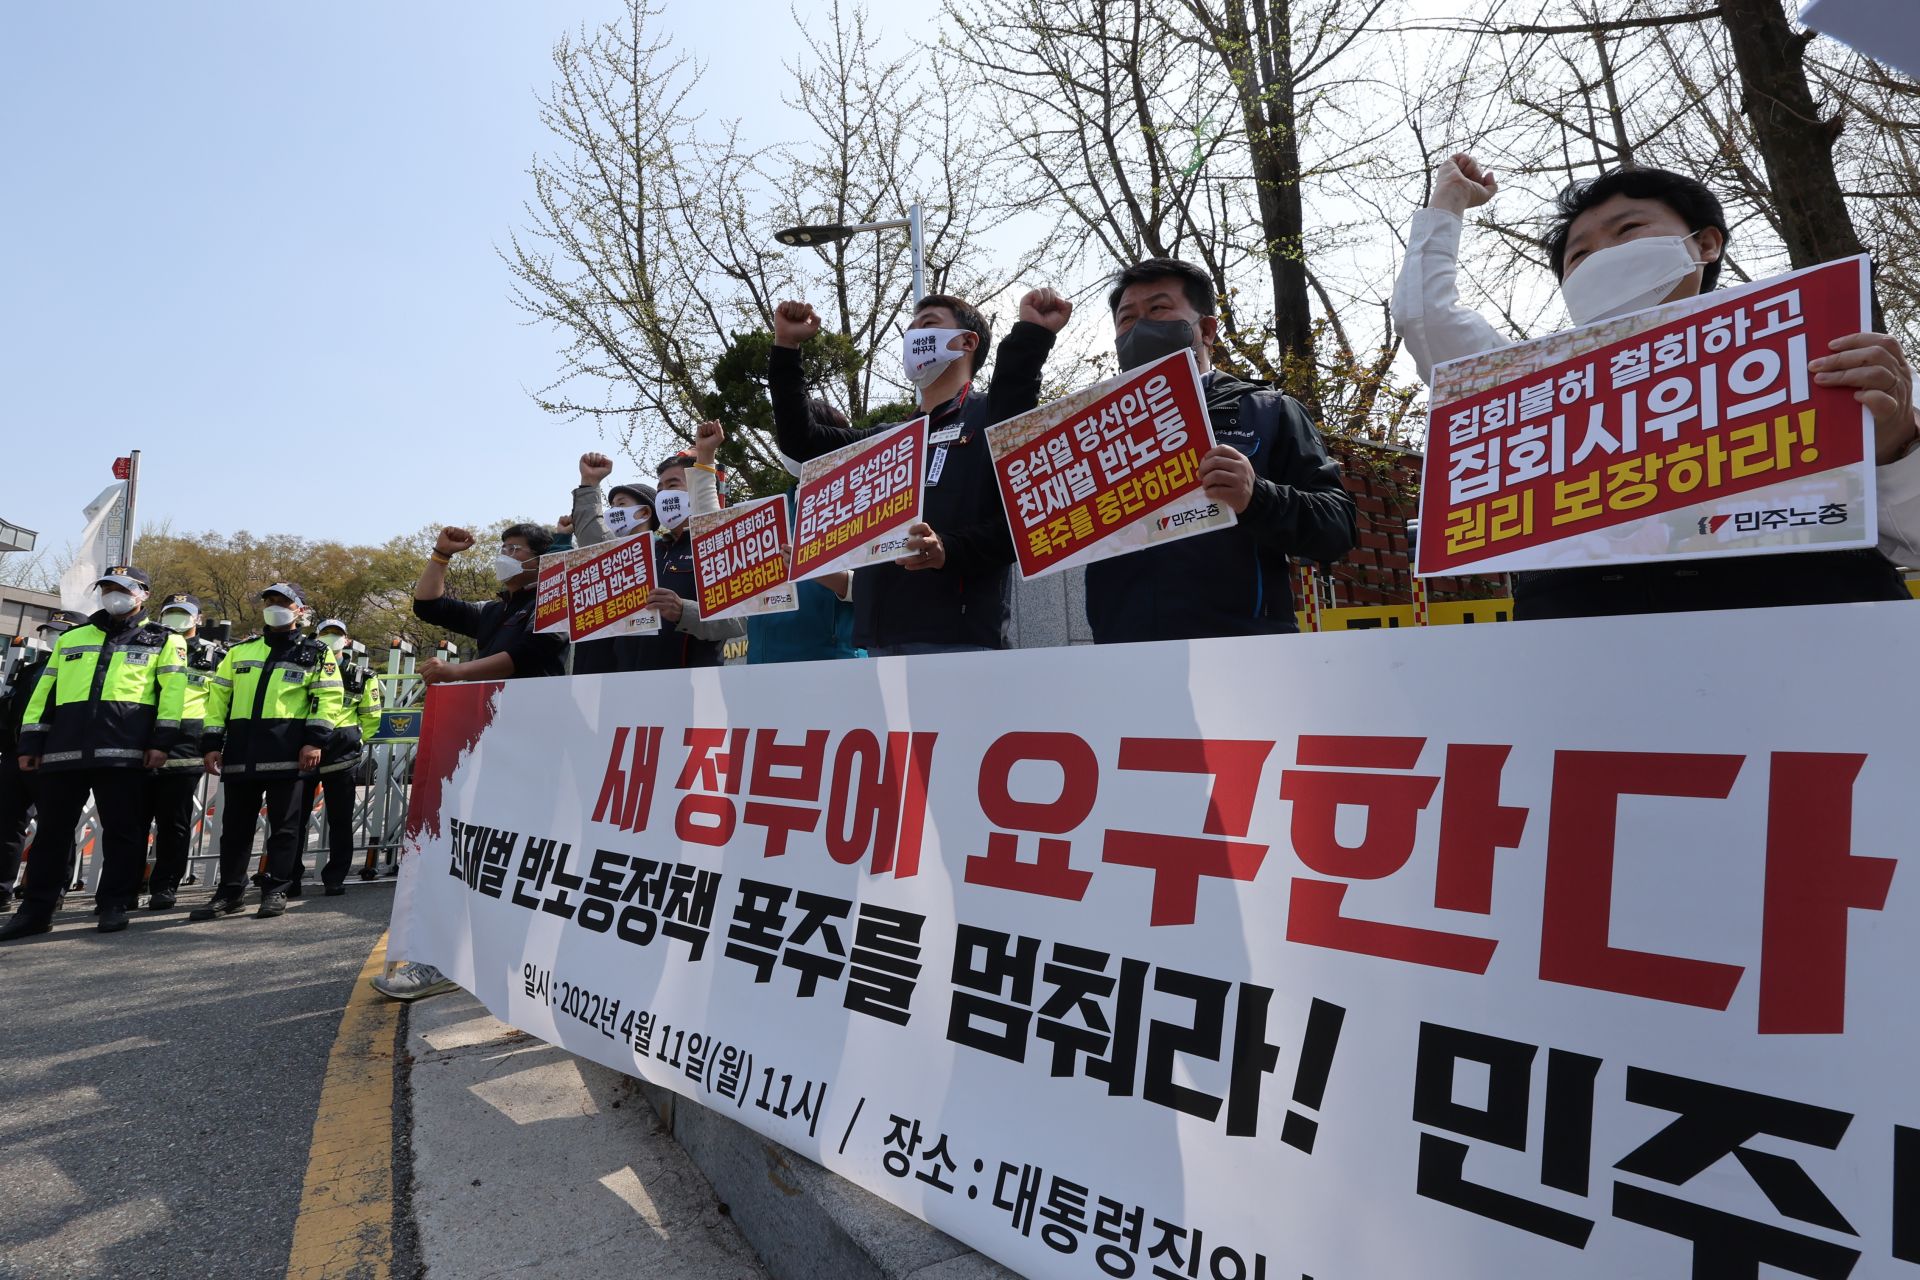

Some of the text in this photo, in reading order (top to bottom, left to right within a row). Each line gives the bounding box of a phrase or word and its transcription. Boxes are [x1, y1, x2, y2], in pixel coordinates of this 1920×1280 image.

[912, 335, 936, 346] 세상을
[912, 345, 936, 355] 바꾸자
[1449, 288, 1804, 446] 집회불허 철회하고
[1007, 432, 1075, 494] 윤석열
[1073, 374, 1175, 453] 당선인은
[1448, 333, 1810, 506] 집회시위의
[802, 475, 845, 519] 윤석열
[849, 435, 914, 491] 당선인은
[1016, 458, 1098, 528] 친재벌
[1097, 407, 1189, 485] 반노동
[1444, 409, 1820, 555] 권리 보장하라!
[661, 497, 680, 505] 세상을
[662, 504, 681, 512] 바꾸자
[800, 459, 914, 545] 민주노총과의
[866, 488, 913, 529] 나서라!
[1027, 448, 1201, 557] 폭주를 중단하라!
[1171, 503, 1220, 526] 민주노총
[1735, 503, 1848, 532] 민주노총
[697, 505, 776, 558] 집회불허 철회하고
[700, 525, 780, 587] 집회시위의
[571, 541, 643, 593] 윤석열 당선인은
[573, 561, 647, 614] 친재벌 반노동
[704, 556, 784, 611] 권리 보장하라!
[575, 605, 605, 631] 폭주를
[591, 726, 1898, 1035] 새 정부에 요구한다
[449, 817, 1920, 1280] 친재벌 반노동정책 폭주를 멈춰라! 민주
[524, 963, 550, 1006] 일시
[561, 981, 620, 1040] 2022년
[620, 1009, 656, 1057] 4월
[656, 1024, 753, 1109] 11일(월)
[755, 1067, 827, 1138] 11시
[882, 1112, 958, 1195] 장소
